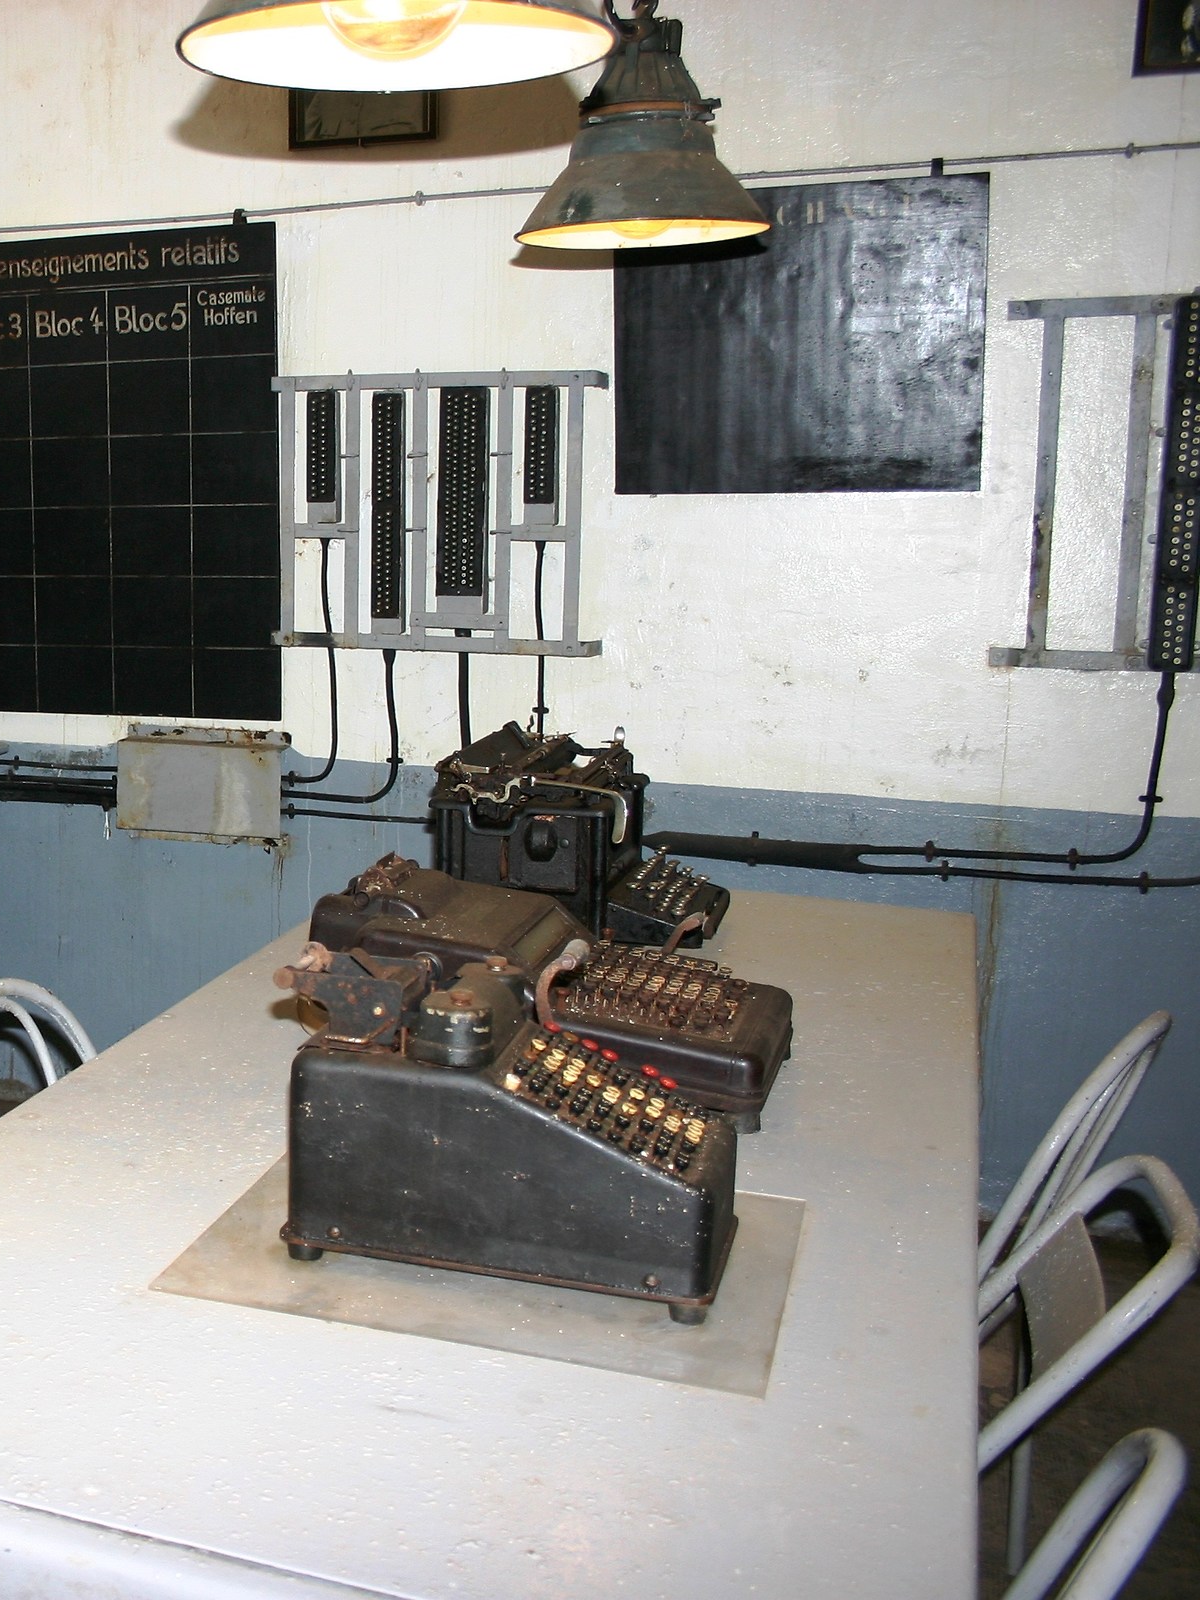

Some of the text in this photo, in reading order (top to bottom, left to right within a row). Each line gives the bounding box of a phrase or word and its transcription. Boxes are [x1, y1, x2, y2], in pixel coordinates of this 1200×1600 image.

[160, 237, 241, 268] relatifs
[8, 312, 22, 339] 3
[35, 306, 104, 338] Bloc 4
[114, 302, 188, 335] Bloc 5
[203, 305, 258, 327] Hoffen
